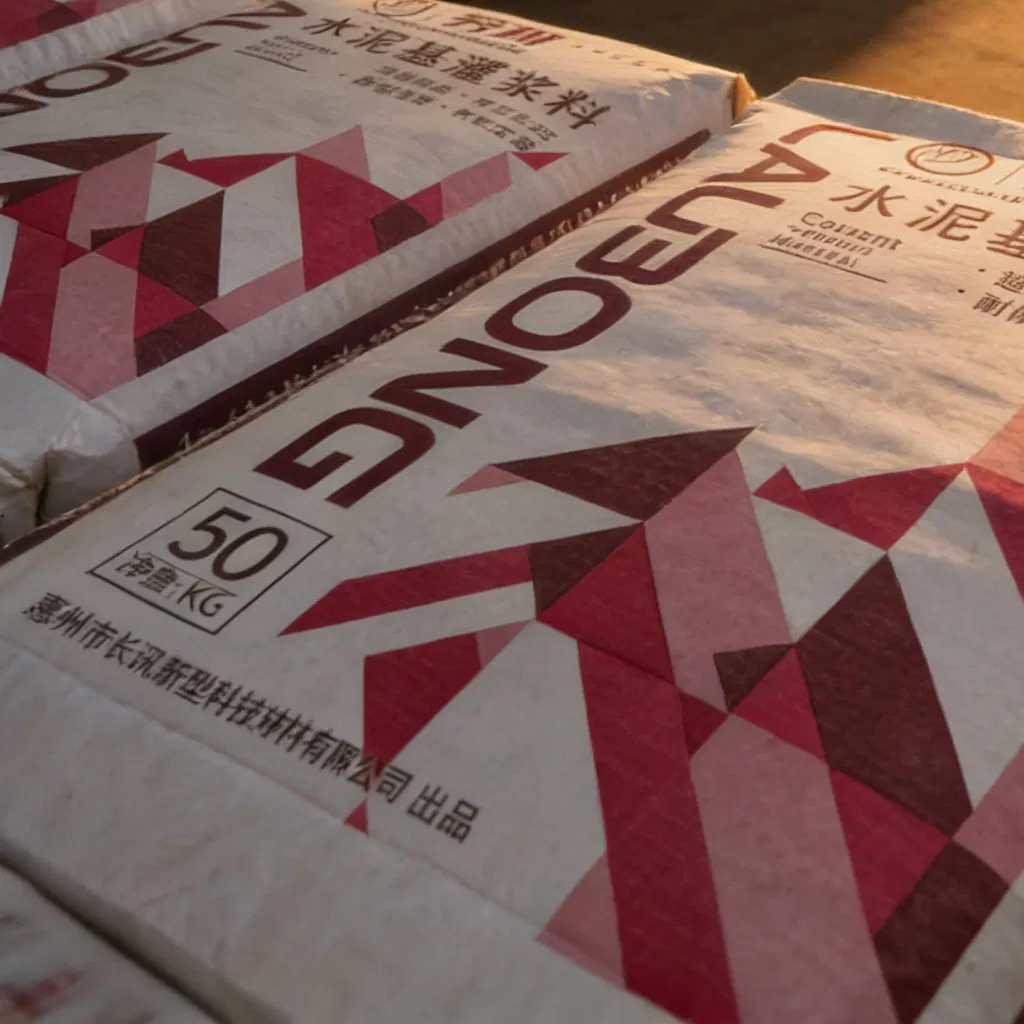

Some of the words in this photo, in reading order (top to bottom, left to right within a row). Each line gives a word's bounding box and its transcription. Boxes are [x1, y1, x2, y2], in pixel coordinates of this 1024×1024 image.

[302, 17, 611, 129] 水泥基灌浆料
[253, 123, 898, 508] LAUBONG
[167, 506, 289, 581] 50
[405, 784, 480, 844] 出品
